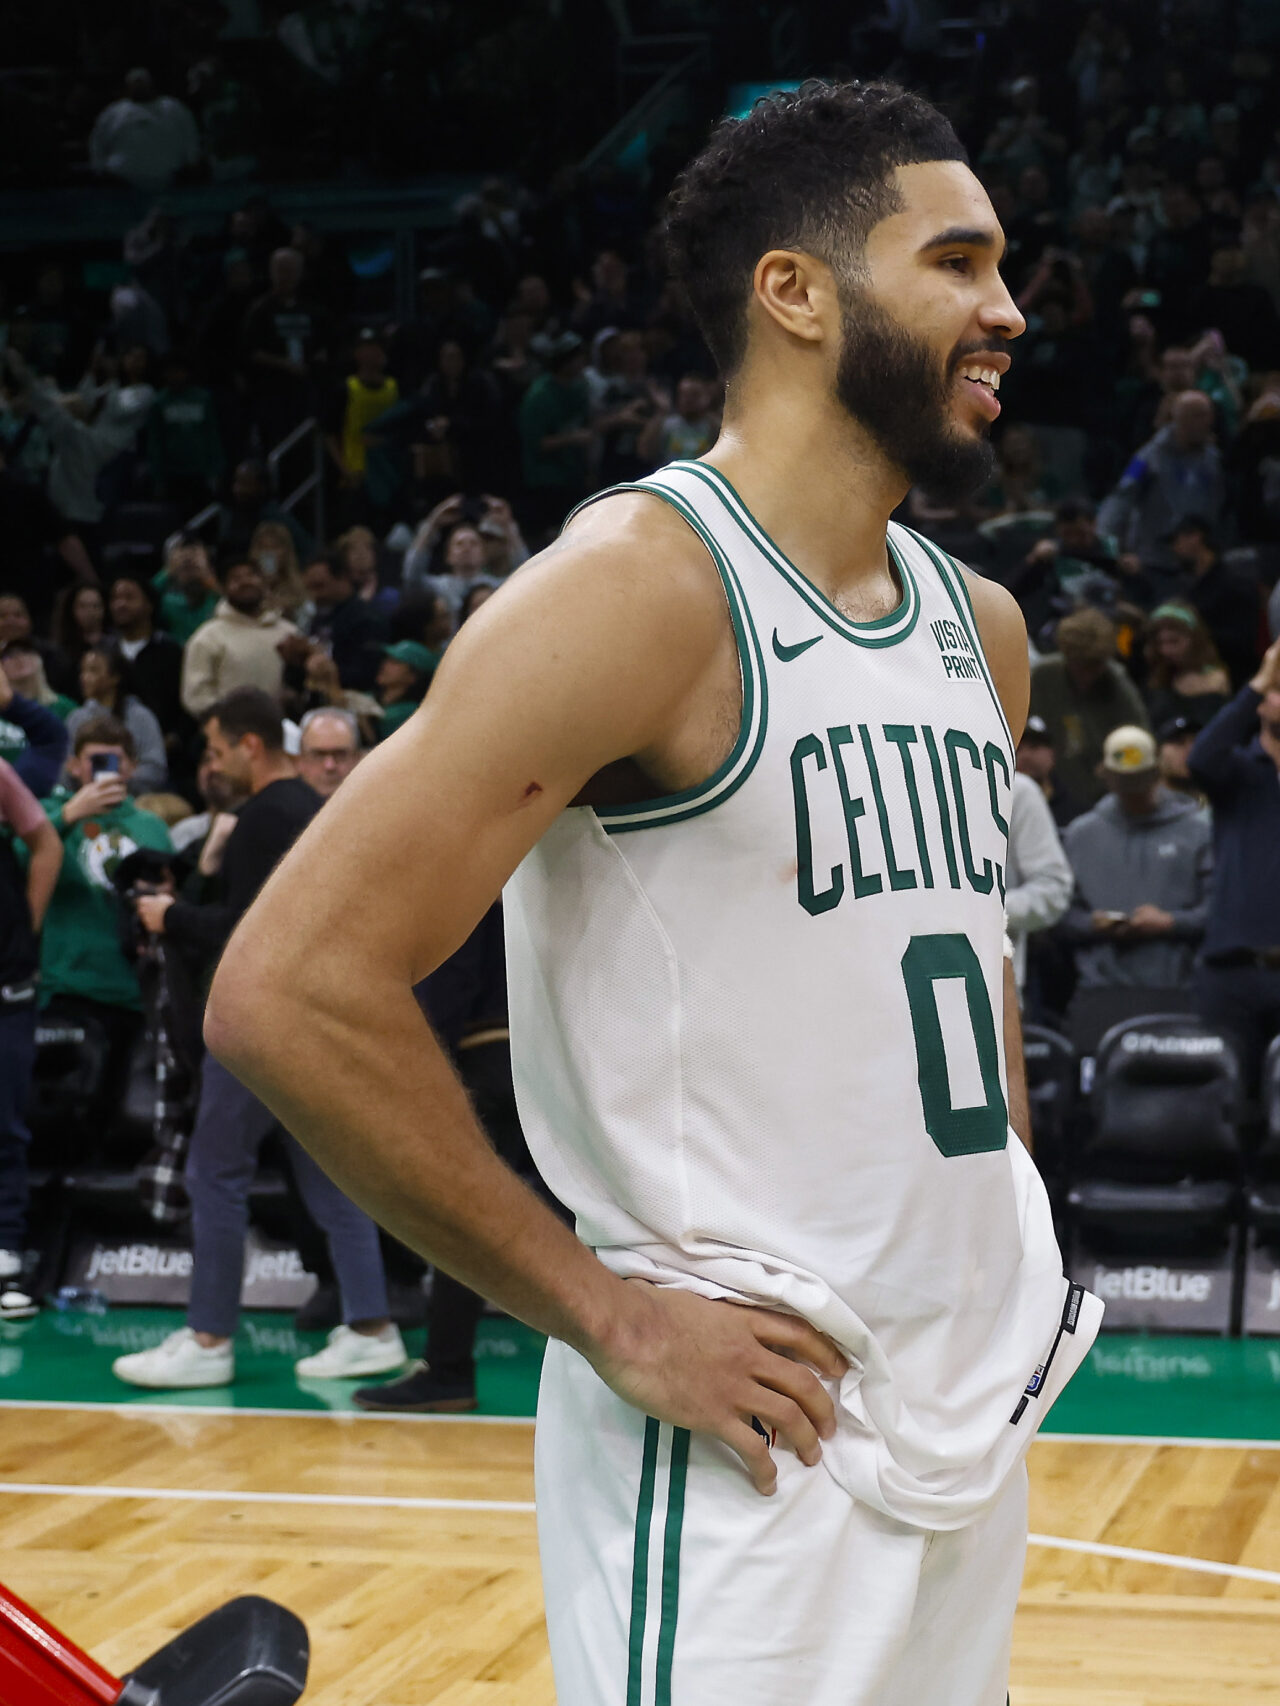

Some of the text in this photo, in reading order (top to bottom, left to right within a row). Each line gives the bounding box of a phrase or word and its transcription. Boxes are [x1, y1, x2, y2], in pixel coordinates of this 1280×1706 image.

[930, 619, 974, 657] VISTA
[942, 655, 982, 680] PRINT
[790, 723, 1011, 917] CELTICS
[900, 933, 1008, 1158] 0
[84, 1243, 195, 1281] jetBlue
[1094, 1265, 1213, 1302] jetBlue
